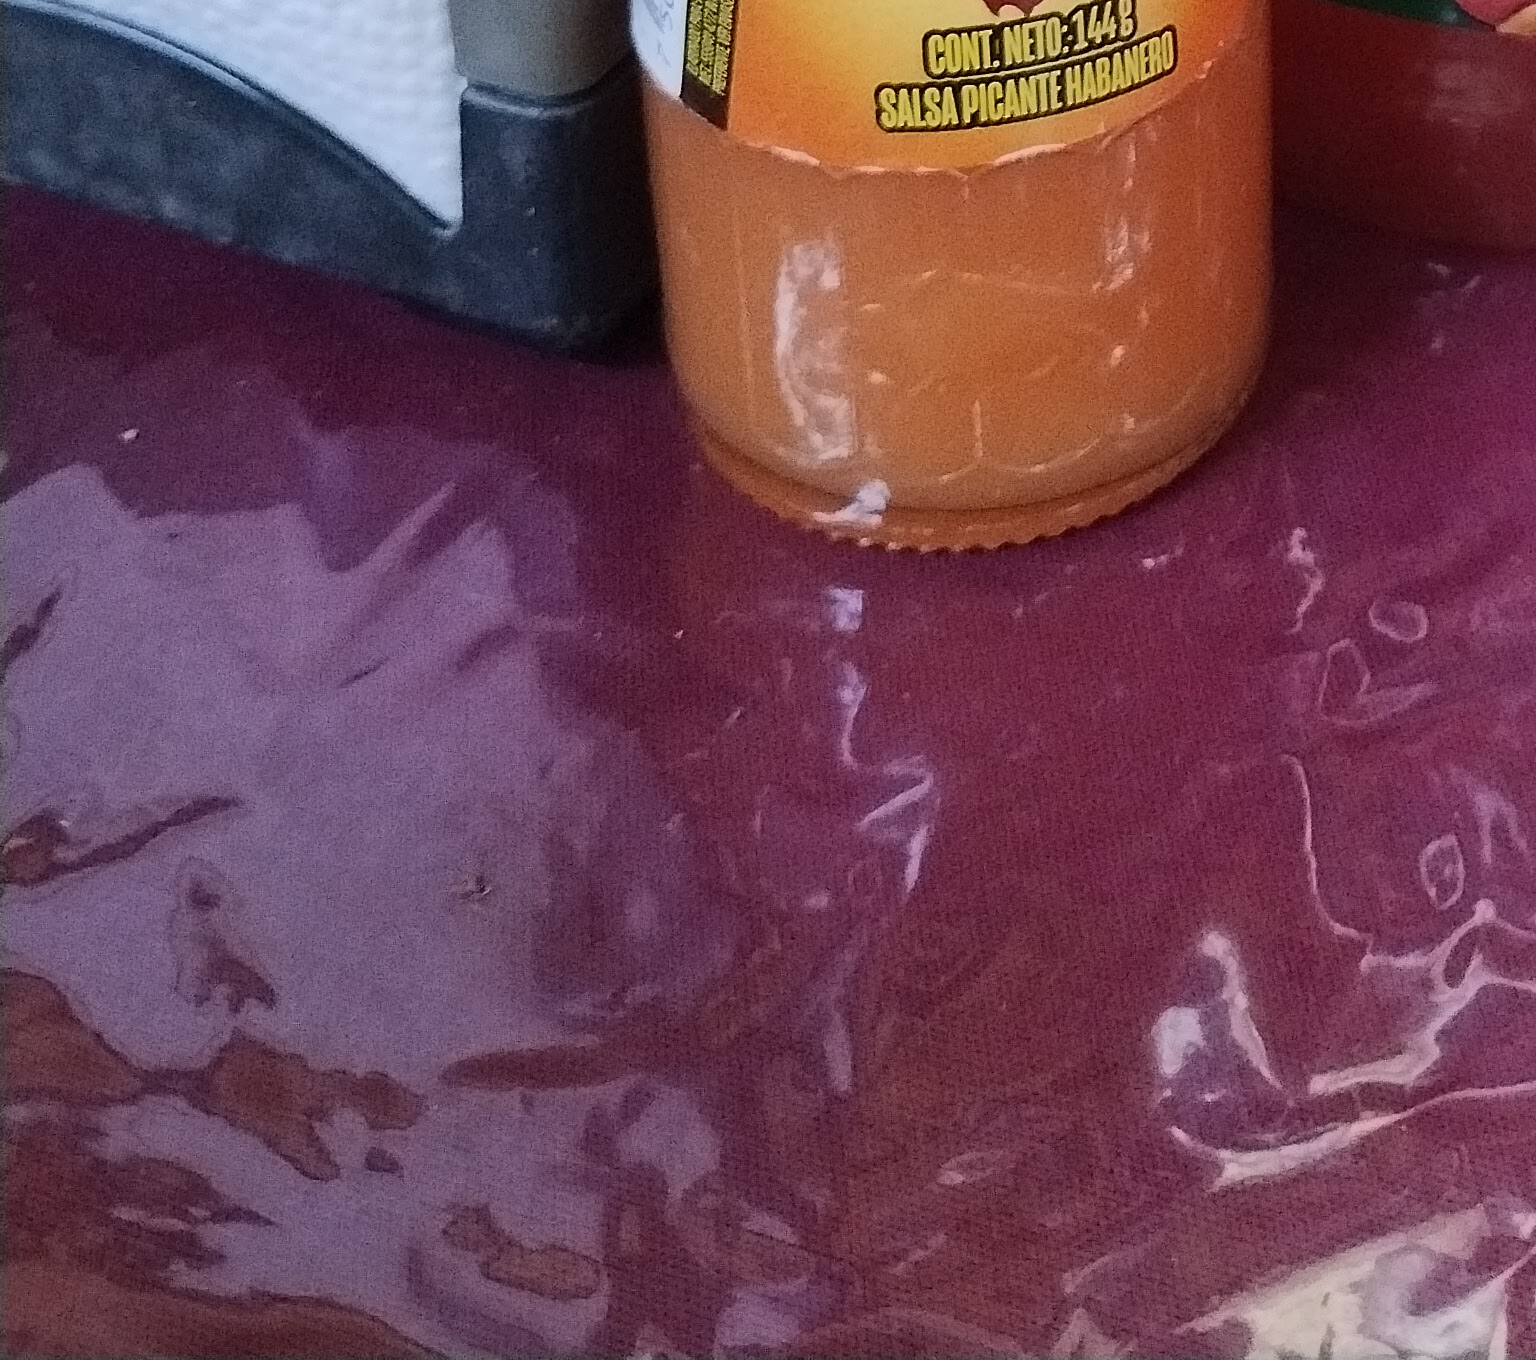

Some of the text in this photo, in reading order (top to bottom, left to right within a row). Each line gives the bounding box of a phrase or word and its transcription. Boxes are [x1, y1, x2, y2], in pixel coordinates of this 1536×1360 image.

[878, 29, 1175, 128] SALSA PICANTE HABANERO
[926, 28, 1000, 76] CONT.
[1001, 15, 1069, 66] NETO:
